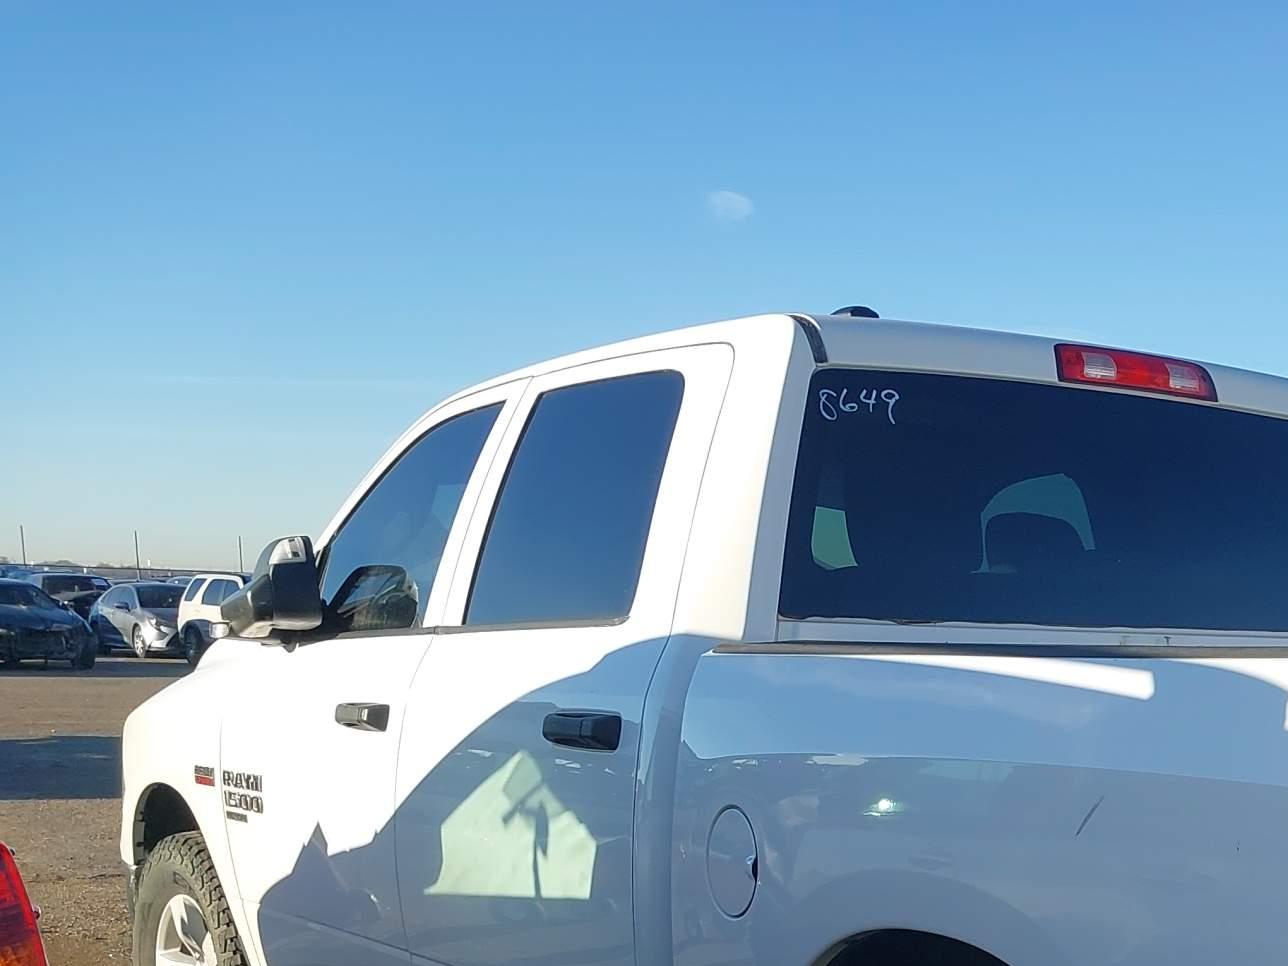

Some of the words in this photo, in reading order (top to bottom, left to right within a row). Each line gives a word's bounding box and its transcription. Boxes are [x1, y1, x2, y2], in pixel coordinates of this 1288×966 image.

[819, 388, 900, 425] 8649
[222, 769, 263, 793] RAM
[223, 790, 264, 814] 1500
